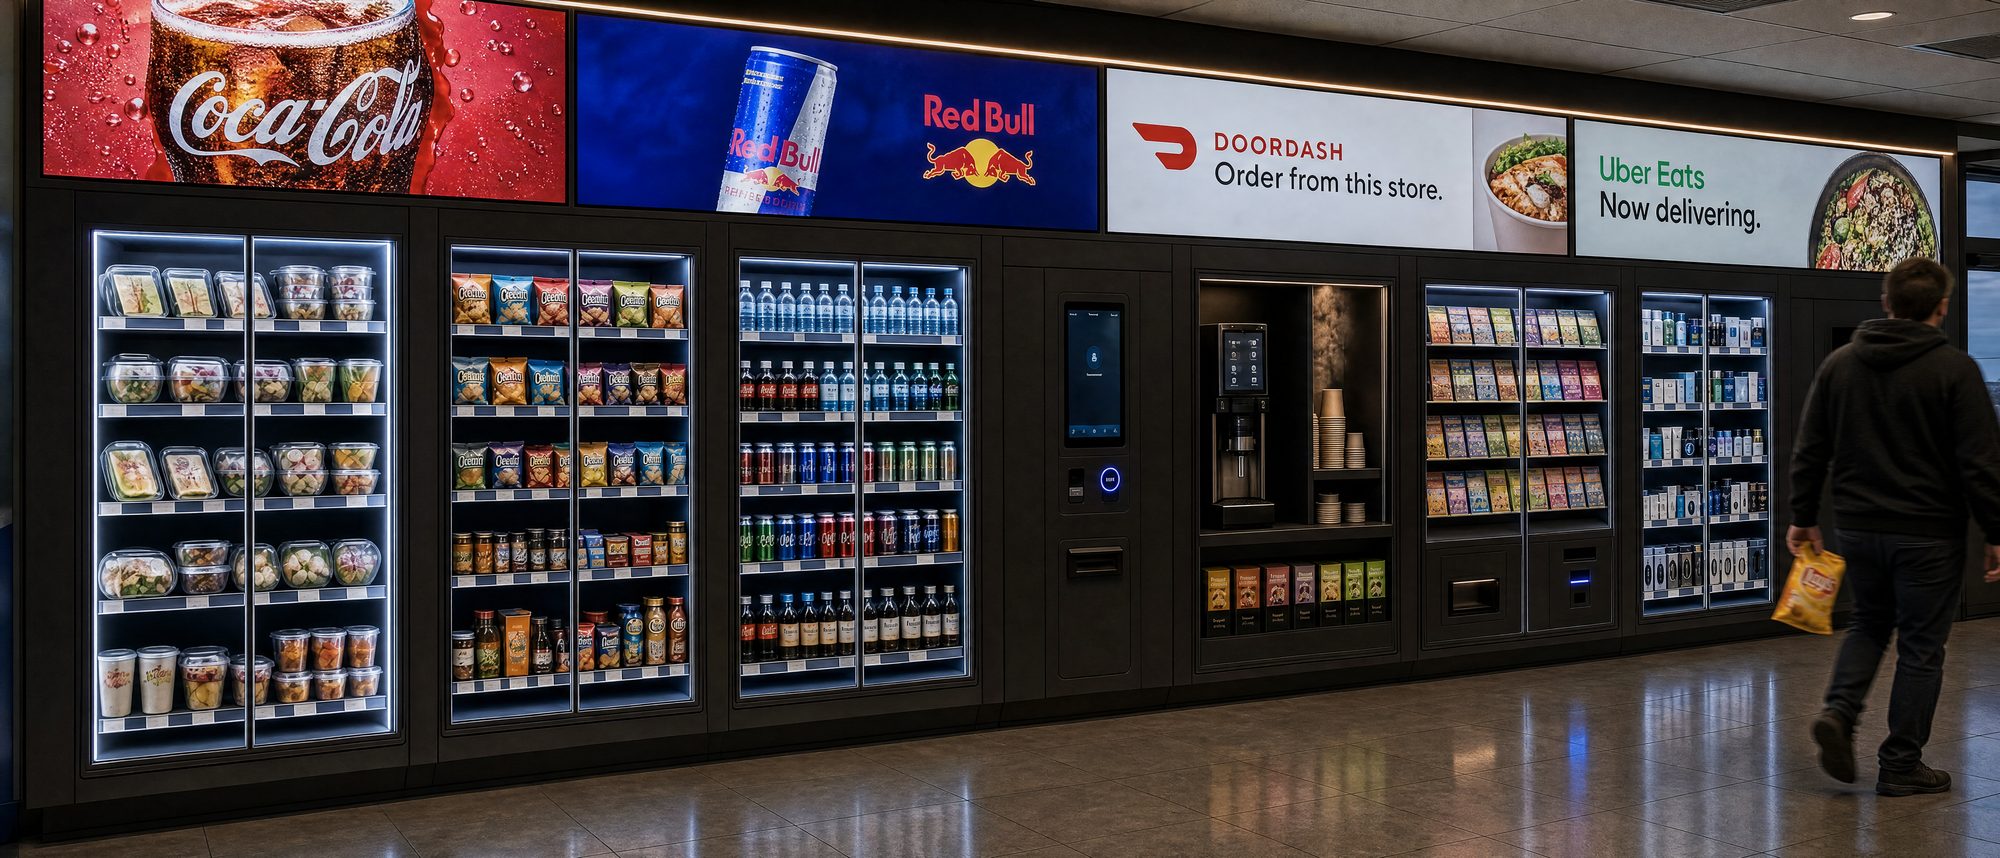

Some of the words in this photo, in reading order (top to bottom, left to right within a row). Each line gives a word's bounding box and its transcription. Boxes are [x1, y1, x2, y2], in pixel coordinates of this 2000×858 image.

[168, 55, 423, 167] Coca-Cola
[923, 93, 980, 131] Red
[985, 101, 1035, 136] Bull
[729, 128, 779, 163] Red
[779, 139, 821, 174] Bull
[1214, 132, 1343, 161] DOORDASH
[1214, 161, 1284, 190] Order
[1289, 166, 1339, 193] from
[1345, 172, 1383, 197] this
[1388, 177, 1443, 201] store.
[1599, 155, 1652, 185] Uber
[1657, 160, 1705, 190] Eats
[1600, 190, 1649, 221] Now
[1655, 196, 1761, 235] delivering.
